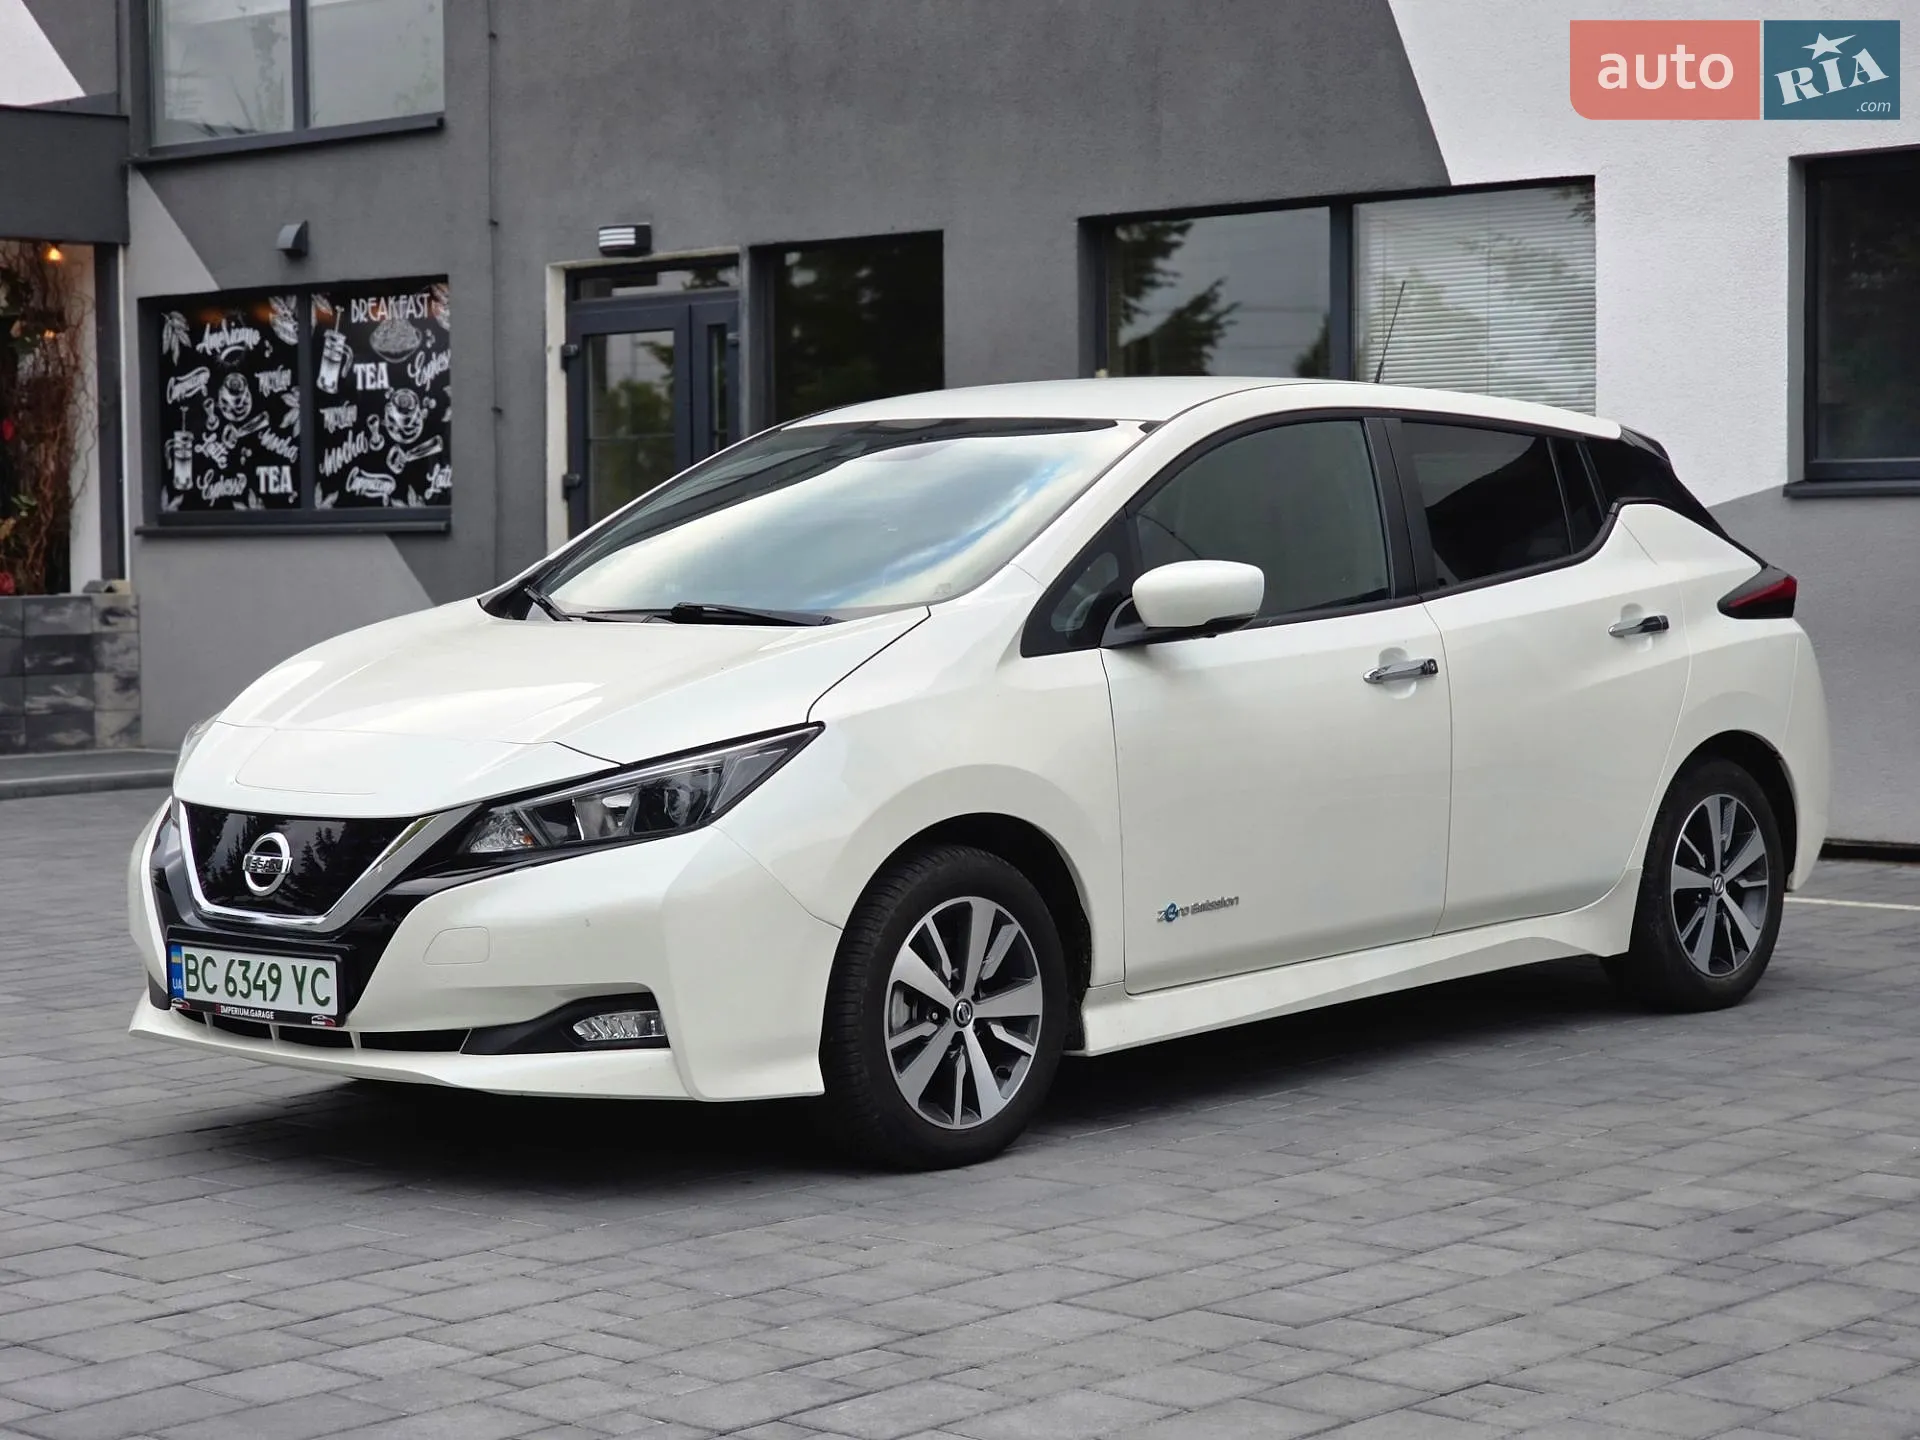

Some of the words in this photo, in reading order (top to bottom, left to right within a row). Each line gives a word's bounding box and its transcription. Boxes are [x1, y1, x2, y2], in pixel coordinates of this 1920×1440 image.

[350, 293, 431, 324] BREAKFAST
[353, 362, 390, 390] TEA
[256, 465, 293, 494] TEA
[172, 978, 182, 990] UA
[184, 953, 218, 995] BC
[224, 959, 282, 1002] 6349
[291, 964, 331, 1007] YC
